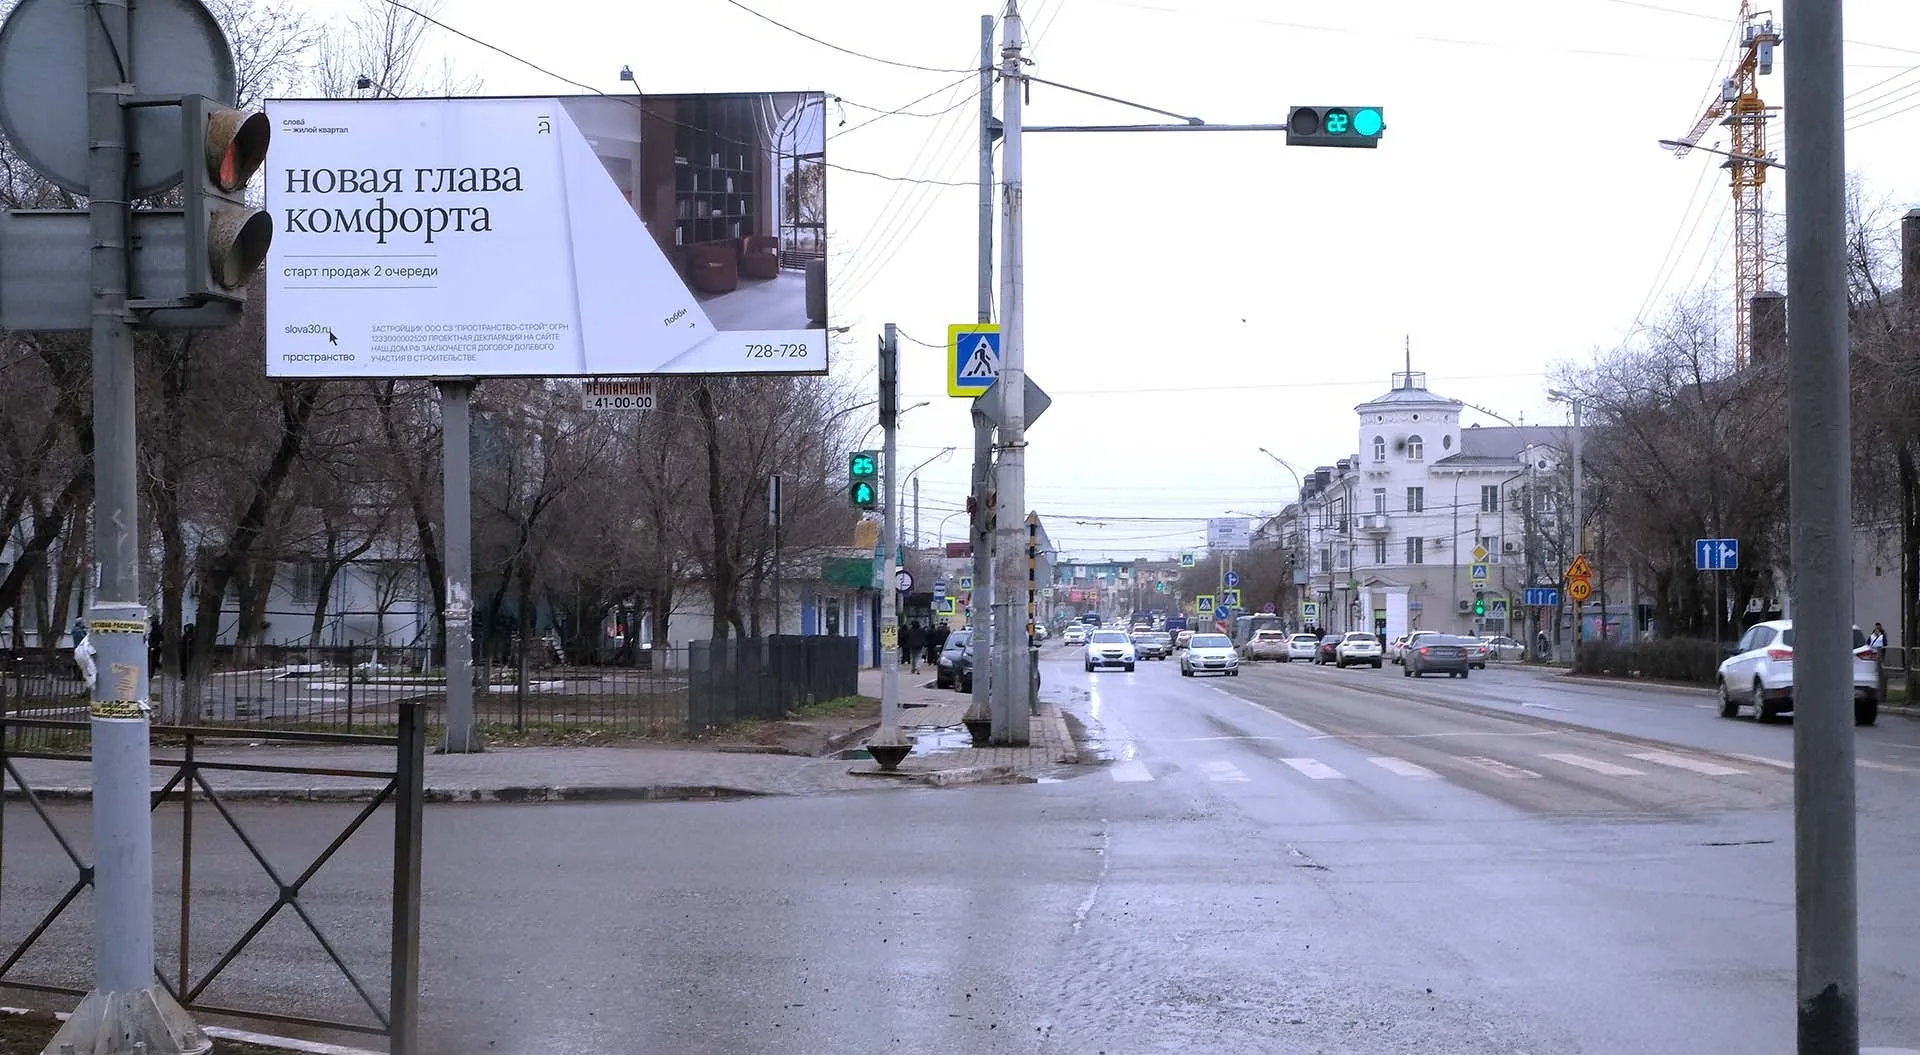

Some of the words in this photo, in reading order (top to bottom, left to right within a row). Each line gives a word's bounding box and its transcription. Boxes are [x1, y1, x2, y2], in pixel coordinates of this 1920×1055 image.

[1327, 113, 1348, 132] 22
[285, 168, 403, 194] новая
[415, 166, 524, 193] глава
[284, 197, 493, 244] комфорта
[283, 267, 318, 279] старт
[322, 266, 370, 279] продаж
[373, 265, 382, 277] 2
[385, 266, 438, 278] очереди
[663, 308, 688, 327] Лобби
[284, 323, 331, 334] slova30.ru
[372, 323, 422, 333] ЗАСТРОЙЩИК
[424, 324, 441, 332] ООО
[443, 324, 453, 332] СЗ
[548, 323, 569, 331] ОГРН
[428, 334, 472, 342] ПРОЕКТНАЯ
[473, 334, 522, 342] ДЕКЛАРАЦИЯ
[523, 333, 534, 341] НА
[535, 332, 560, 341] САЙТЕ
[421, 343, 476, 352] ЗАКЛЮЧАЕТСЯ
[477, 343, 513, 352] ДОГОВОР
[513, 343, 554, 351] ДОЛЕВОГО
[745, 343, 808, 358] 728-728
[282, 353, 356, 364] пространство
[371, 354, 406, 362] УЧАСТИЯ
[413, 354, 476, 362] СТРОИТЕЛЬСТВЕ
[594, 396, 652, 409] 41-00-00
[853, 458, 873, 474] 25
[1573, 585, 1587, 595] 40
